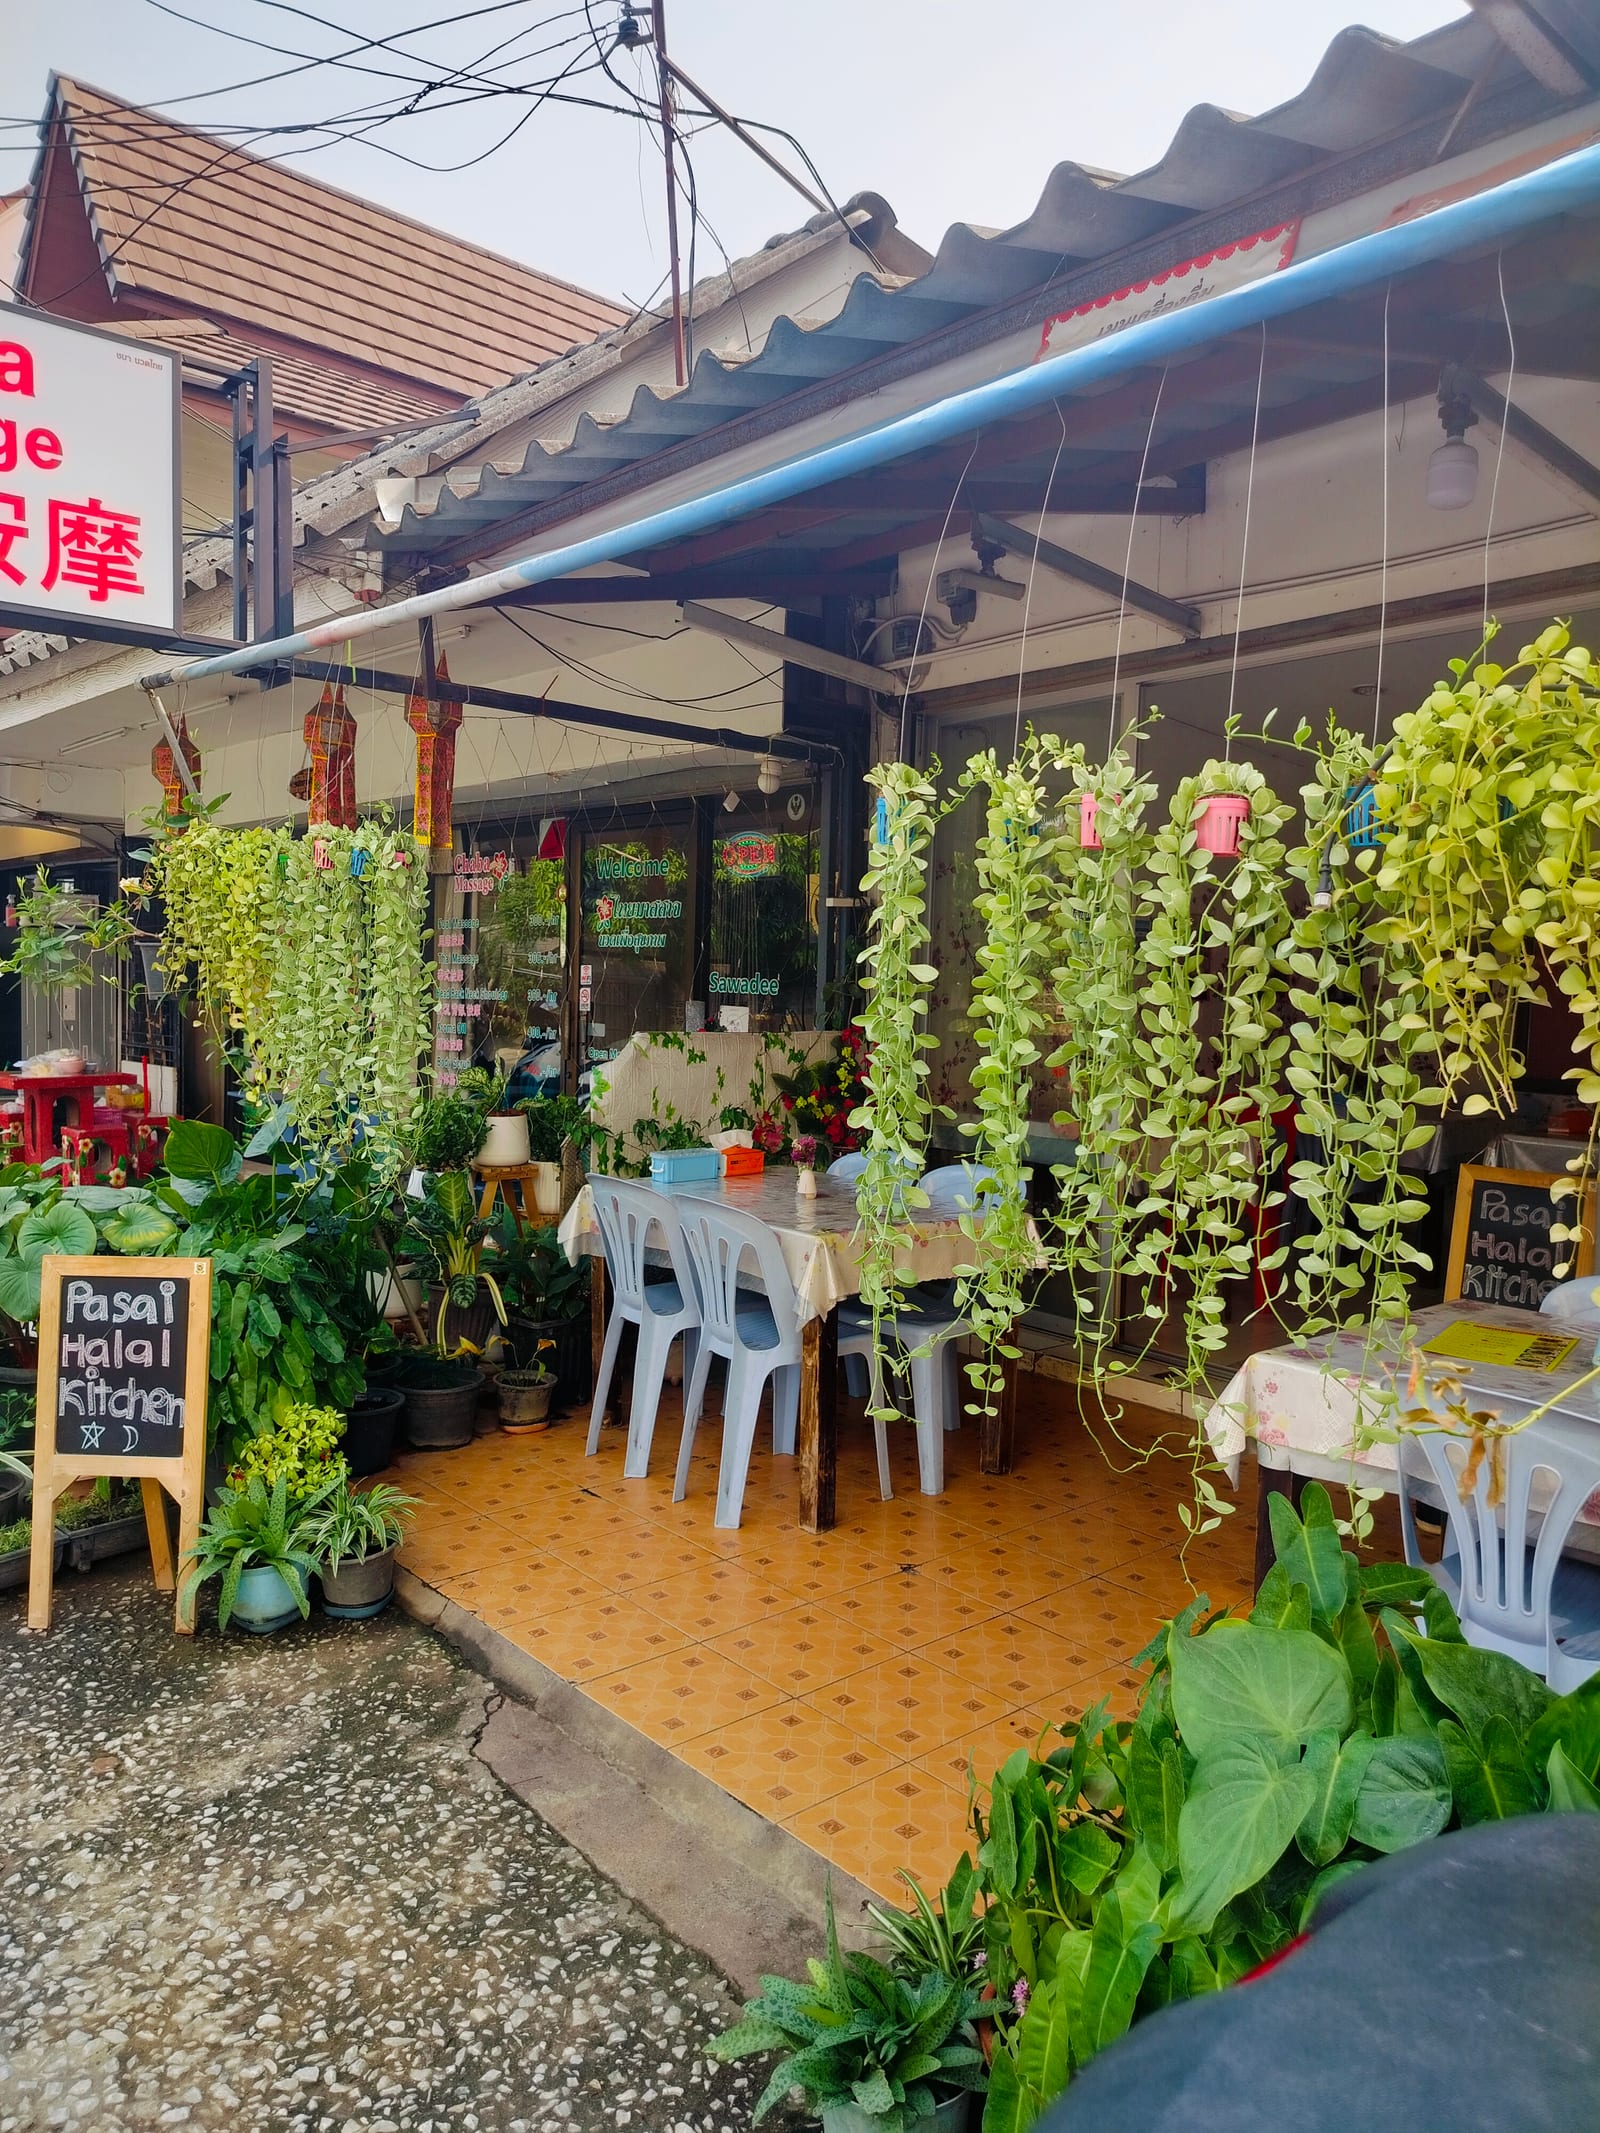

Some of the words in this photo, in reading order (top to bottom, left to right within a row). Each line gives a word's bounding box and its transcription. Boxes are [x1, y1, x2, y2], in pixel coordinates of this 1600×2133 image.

[0, 491, 145, 602] 摩
[453, 852, 491, 874] Chaba
[596, 856, 669, 879] Welcome
[722, 843, 776, 866] OPEN
[454, 876, 494, 895] Massage
[452, 952, 479, 965] Massage
[709, 971, 779, 996] Sawadee
[588, 1047, 608, 1060] Open
[1480, 1189, 1566, 1230] Pasai
[1471, 1231, 1564, 1270] Halal
[1462, 1263, 1559, 1304] Kitche
[66, 1280, 176, 1325] Pasai
[61, 1329, 171, 1369] Halal
[58, 1366, 185, 1428] Kitchen
